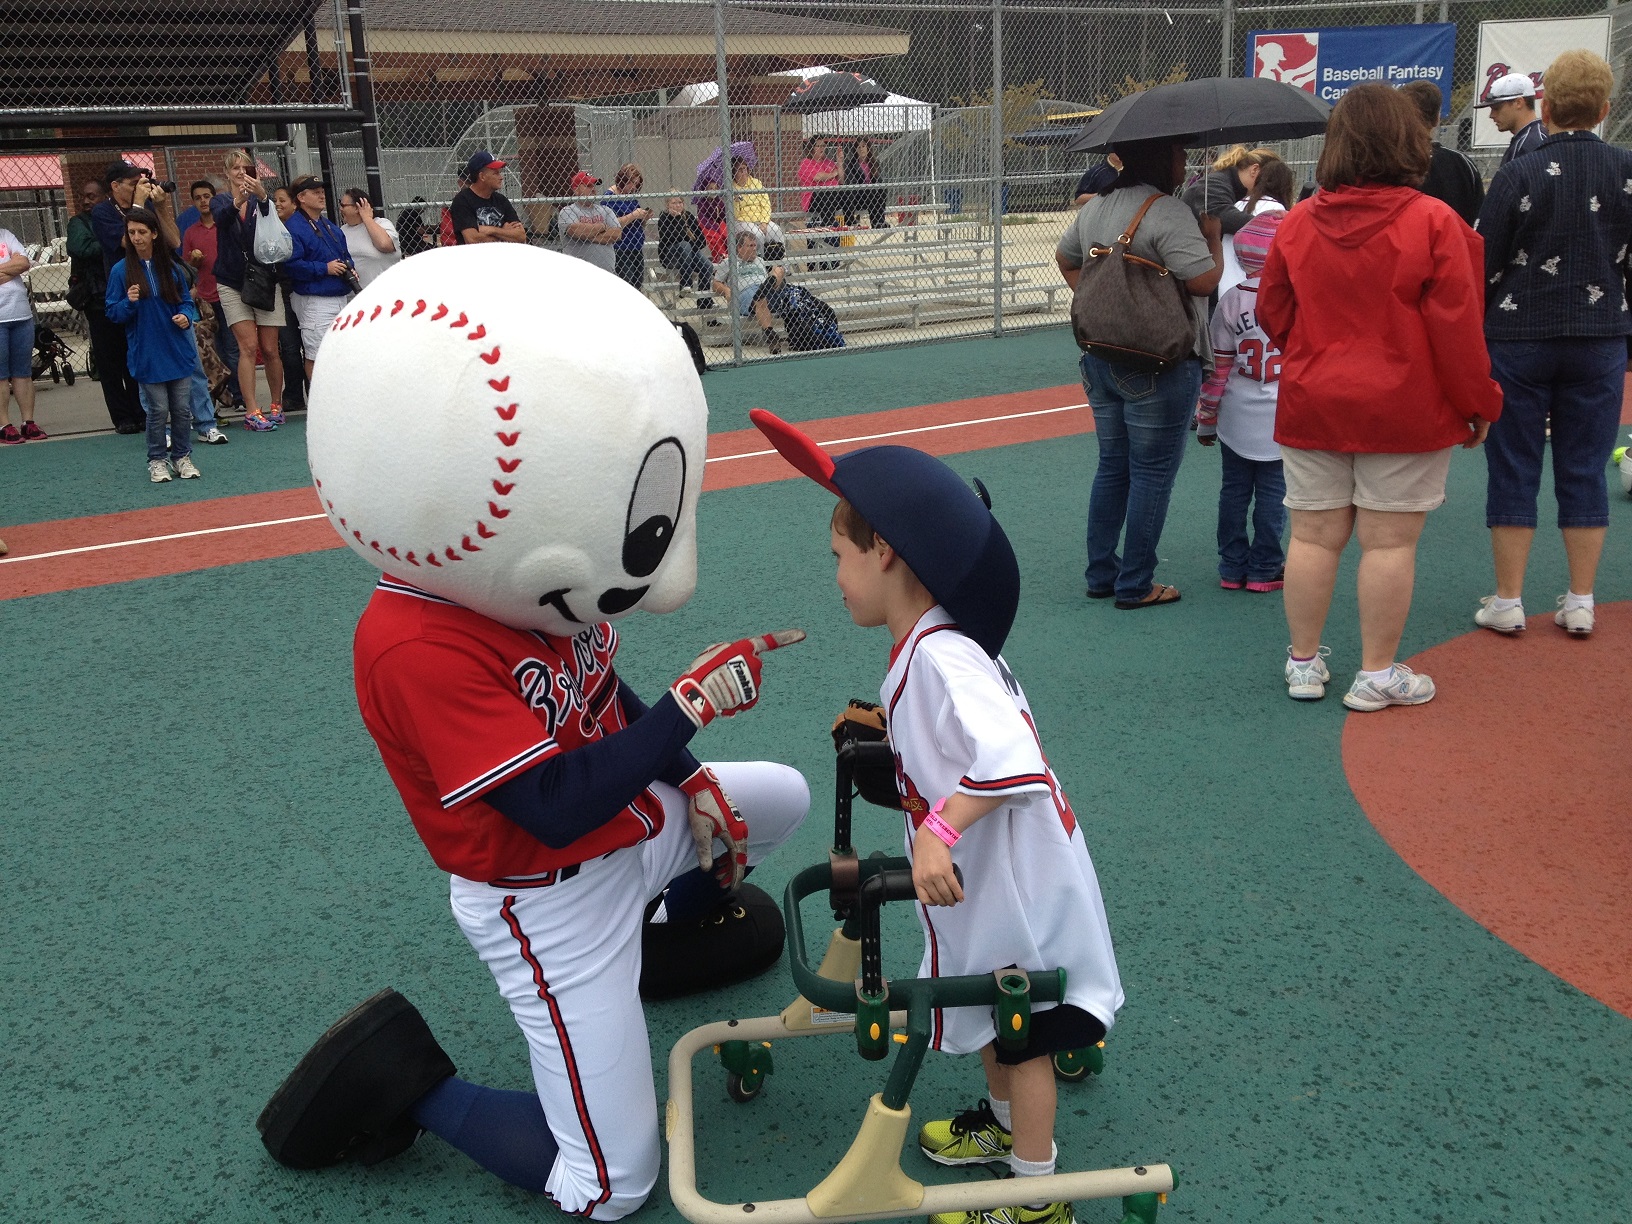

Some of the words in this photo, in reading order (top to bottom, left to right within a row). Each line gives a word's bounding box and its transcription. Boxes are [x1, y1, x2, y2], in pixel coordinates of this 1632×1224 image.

[1323, 66, 1384, 81] Baseball
[1388, 65, 1444, 80] Fantasy
[1238, 339, 1282, 384] 32
[729, 660, 753, 701] Franklin
